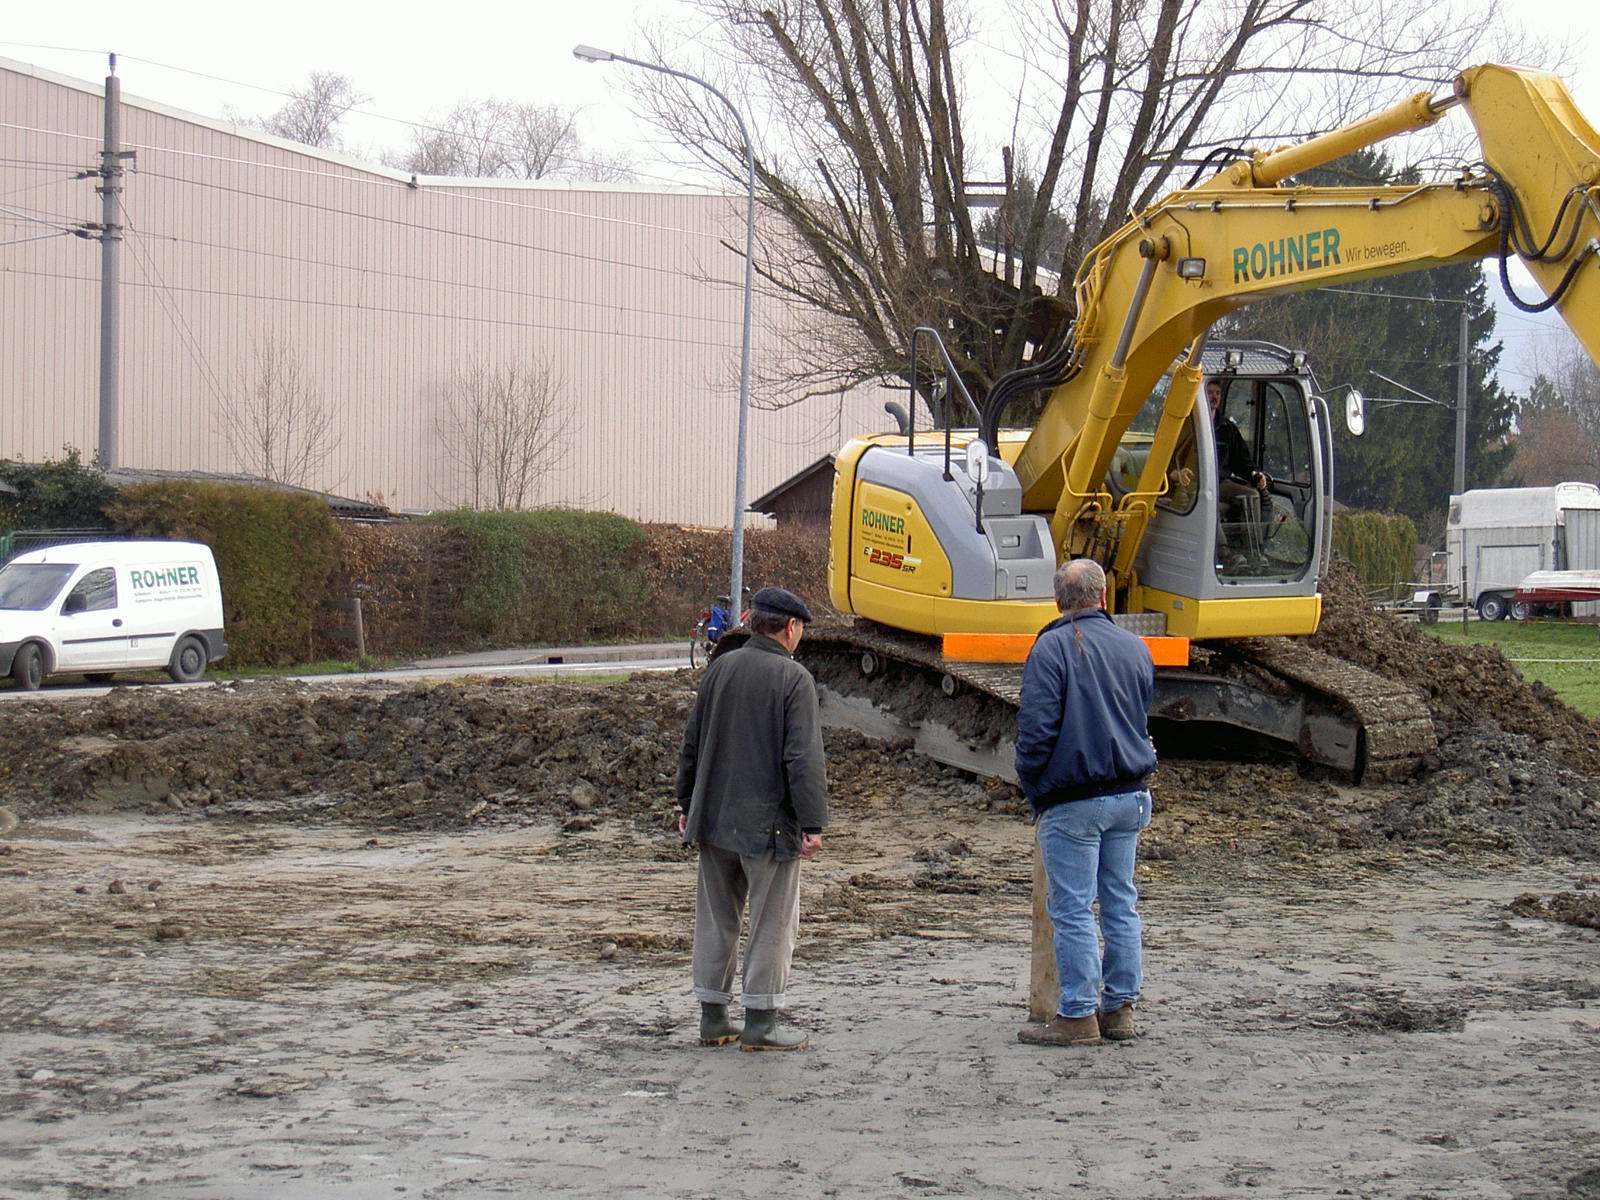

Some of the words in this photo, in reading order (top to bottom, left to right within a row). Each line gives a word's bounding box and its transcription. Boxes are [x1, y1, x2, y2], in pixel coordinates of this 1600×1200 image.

[1233, 228, 1341, 284] ROHNER
[1345, 247, 1362, 264] Wir
[1364, 239, 1410, 259] bewegen.
[862, 509, 905, 535] ROHNER
[130, 566, 200, 589] ROHNER
